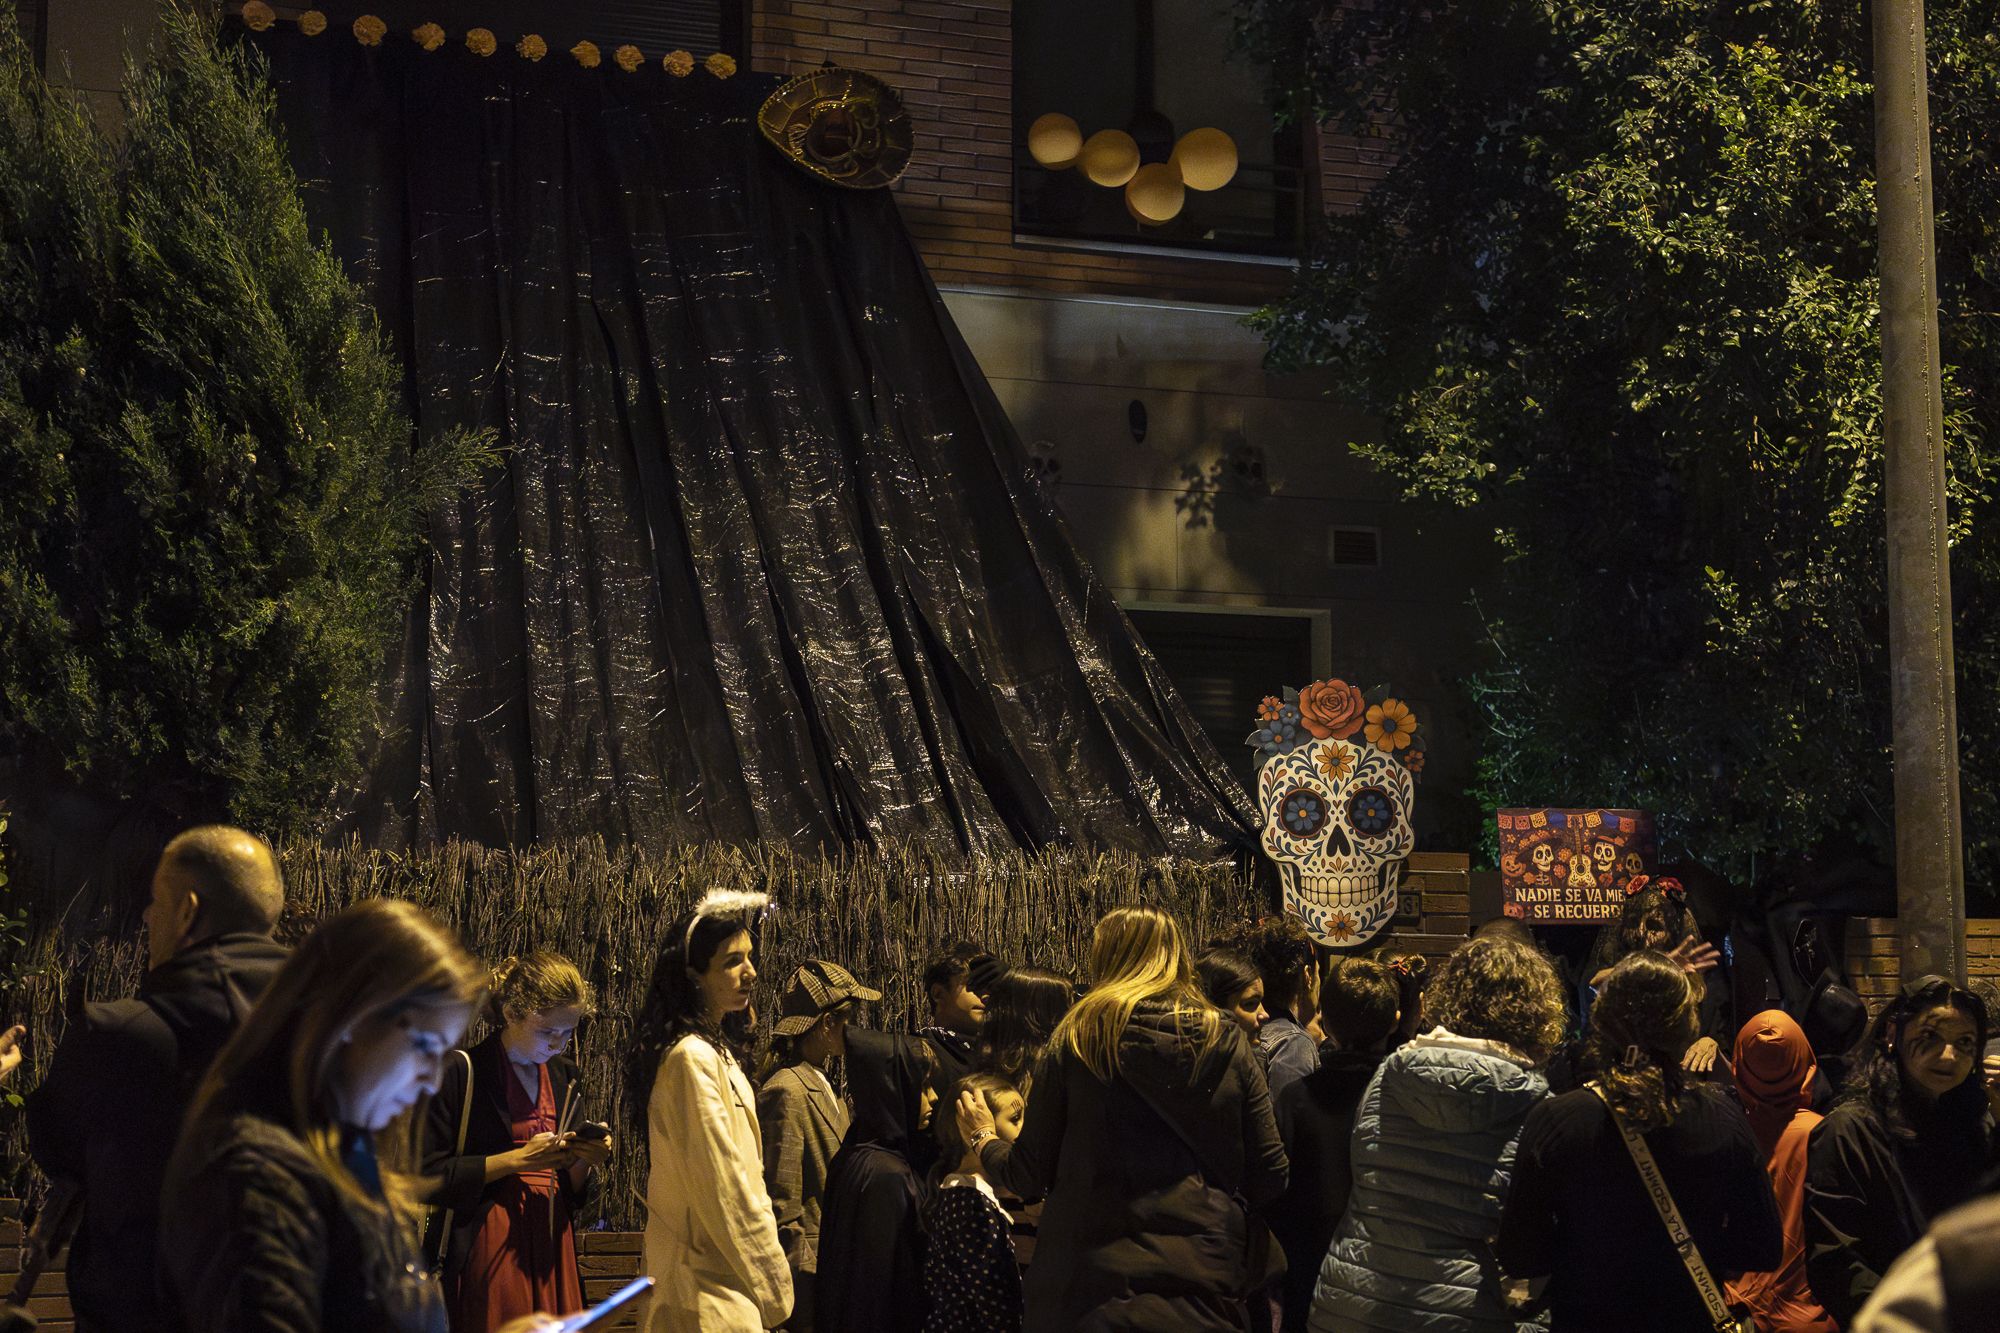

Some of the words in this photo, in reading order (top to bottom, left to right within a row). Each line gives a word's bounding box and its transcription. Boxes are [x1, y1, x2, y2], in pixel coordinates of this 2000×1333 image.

[1515, 888, 1561, 902] NADIE
[1565, 888, 1582, 902] SE
[1585, 888, 1603, 902] VA
[1606, 889, 1626, 902] MIE
[1534, 904, 1551, 919] SE
[1555, 904, 1624, 919] RECUERD
